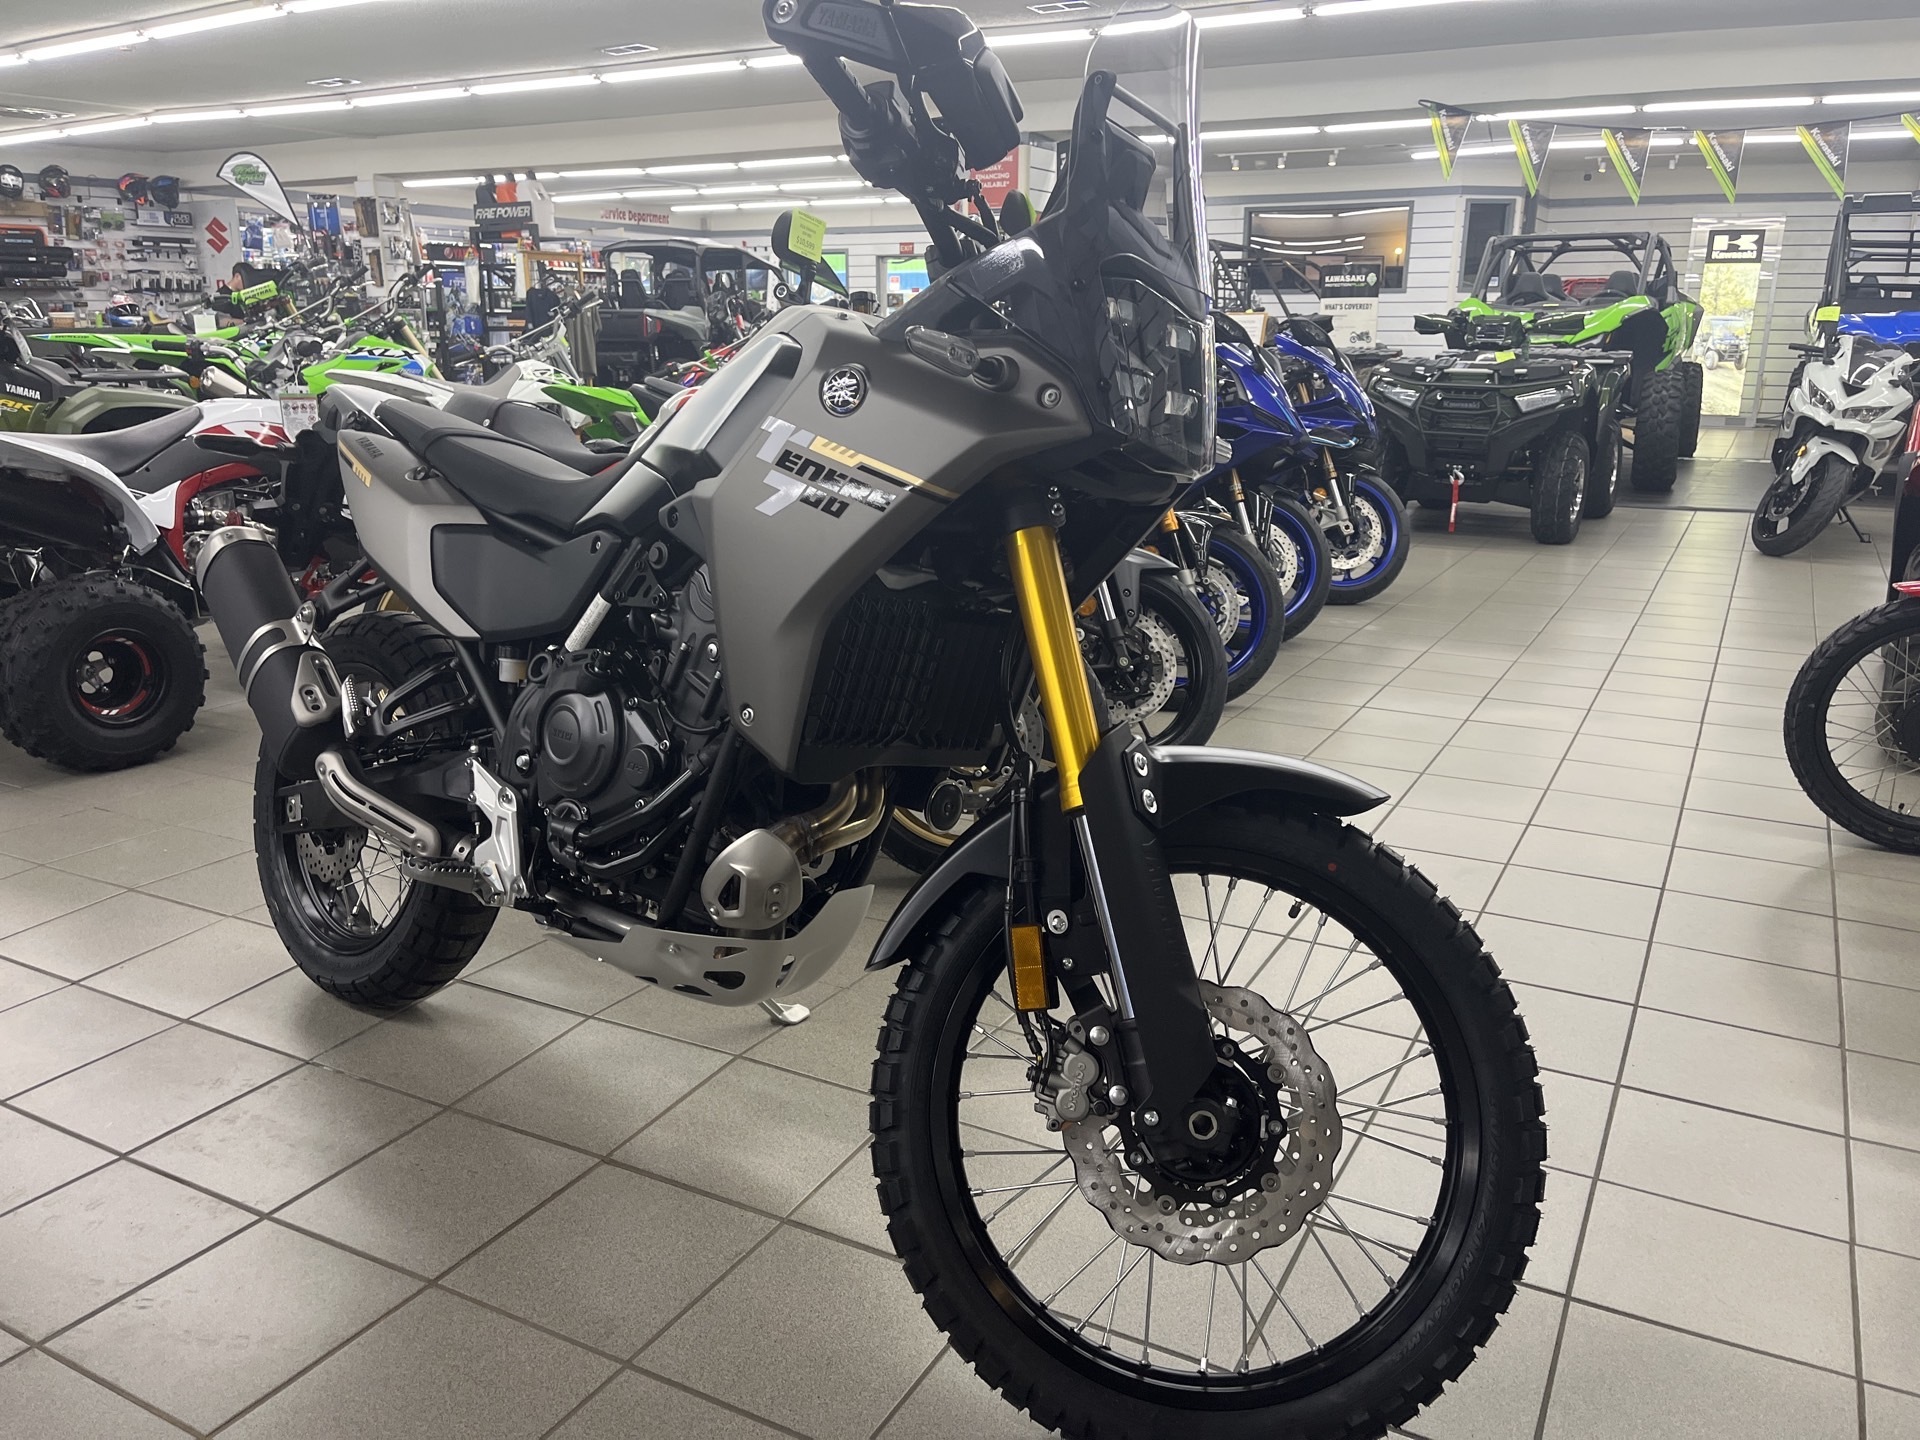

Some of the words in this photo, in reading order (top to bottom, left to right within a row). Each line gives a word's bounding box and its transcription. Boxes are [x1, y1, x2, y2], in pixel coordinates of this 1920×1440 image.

[1439, 109, 1456, 151] Kawasaki
[1521, 123, 1540, 164] Kawasaki
[1615, 131, 1640, 172] Kawasaki
[1707, 131, 1735, 172] Kawasaki
[1810, 127, 1842, 167] Kawasaki
[496, 205, 531, 219] POWER
[628, 209, 670, 225] Department
[1711, 250, 1757, 259] Kawasaki
[1324, 275, 1366, 283] KAWASAKI
[1324, 303, 1343, 311] WHAT'S
[1344, 303, 1373, 311] COVERED?
[350, 346, 421, 360] KLX
[5, 383, 41, 400] YAMAHA
[1443, 400, 1480, 409] Kawasaki
[355, 436, 384, 459] YAMAHA
[754, 469, 850, 519] 700
[1064, 1062, 1087, 1112] brembo
